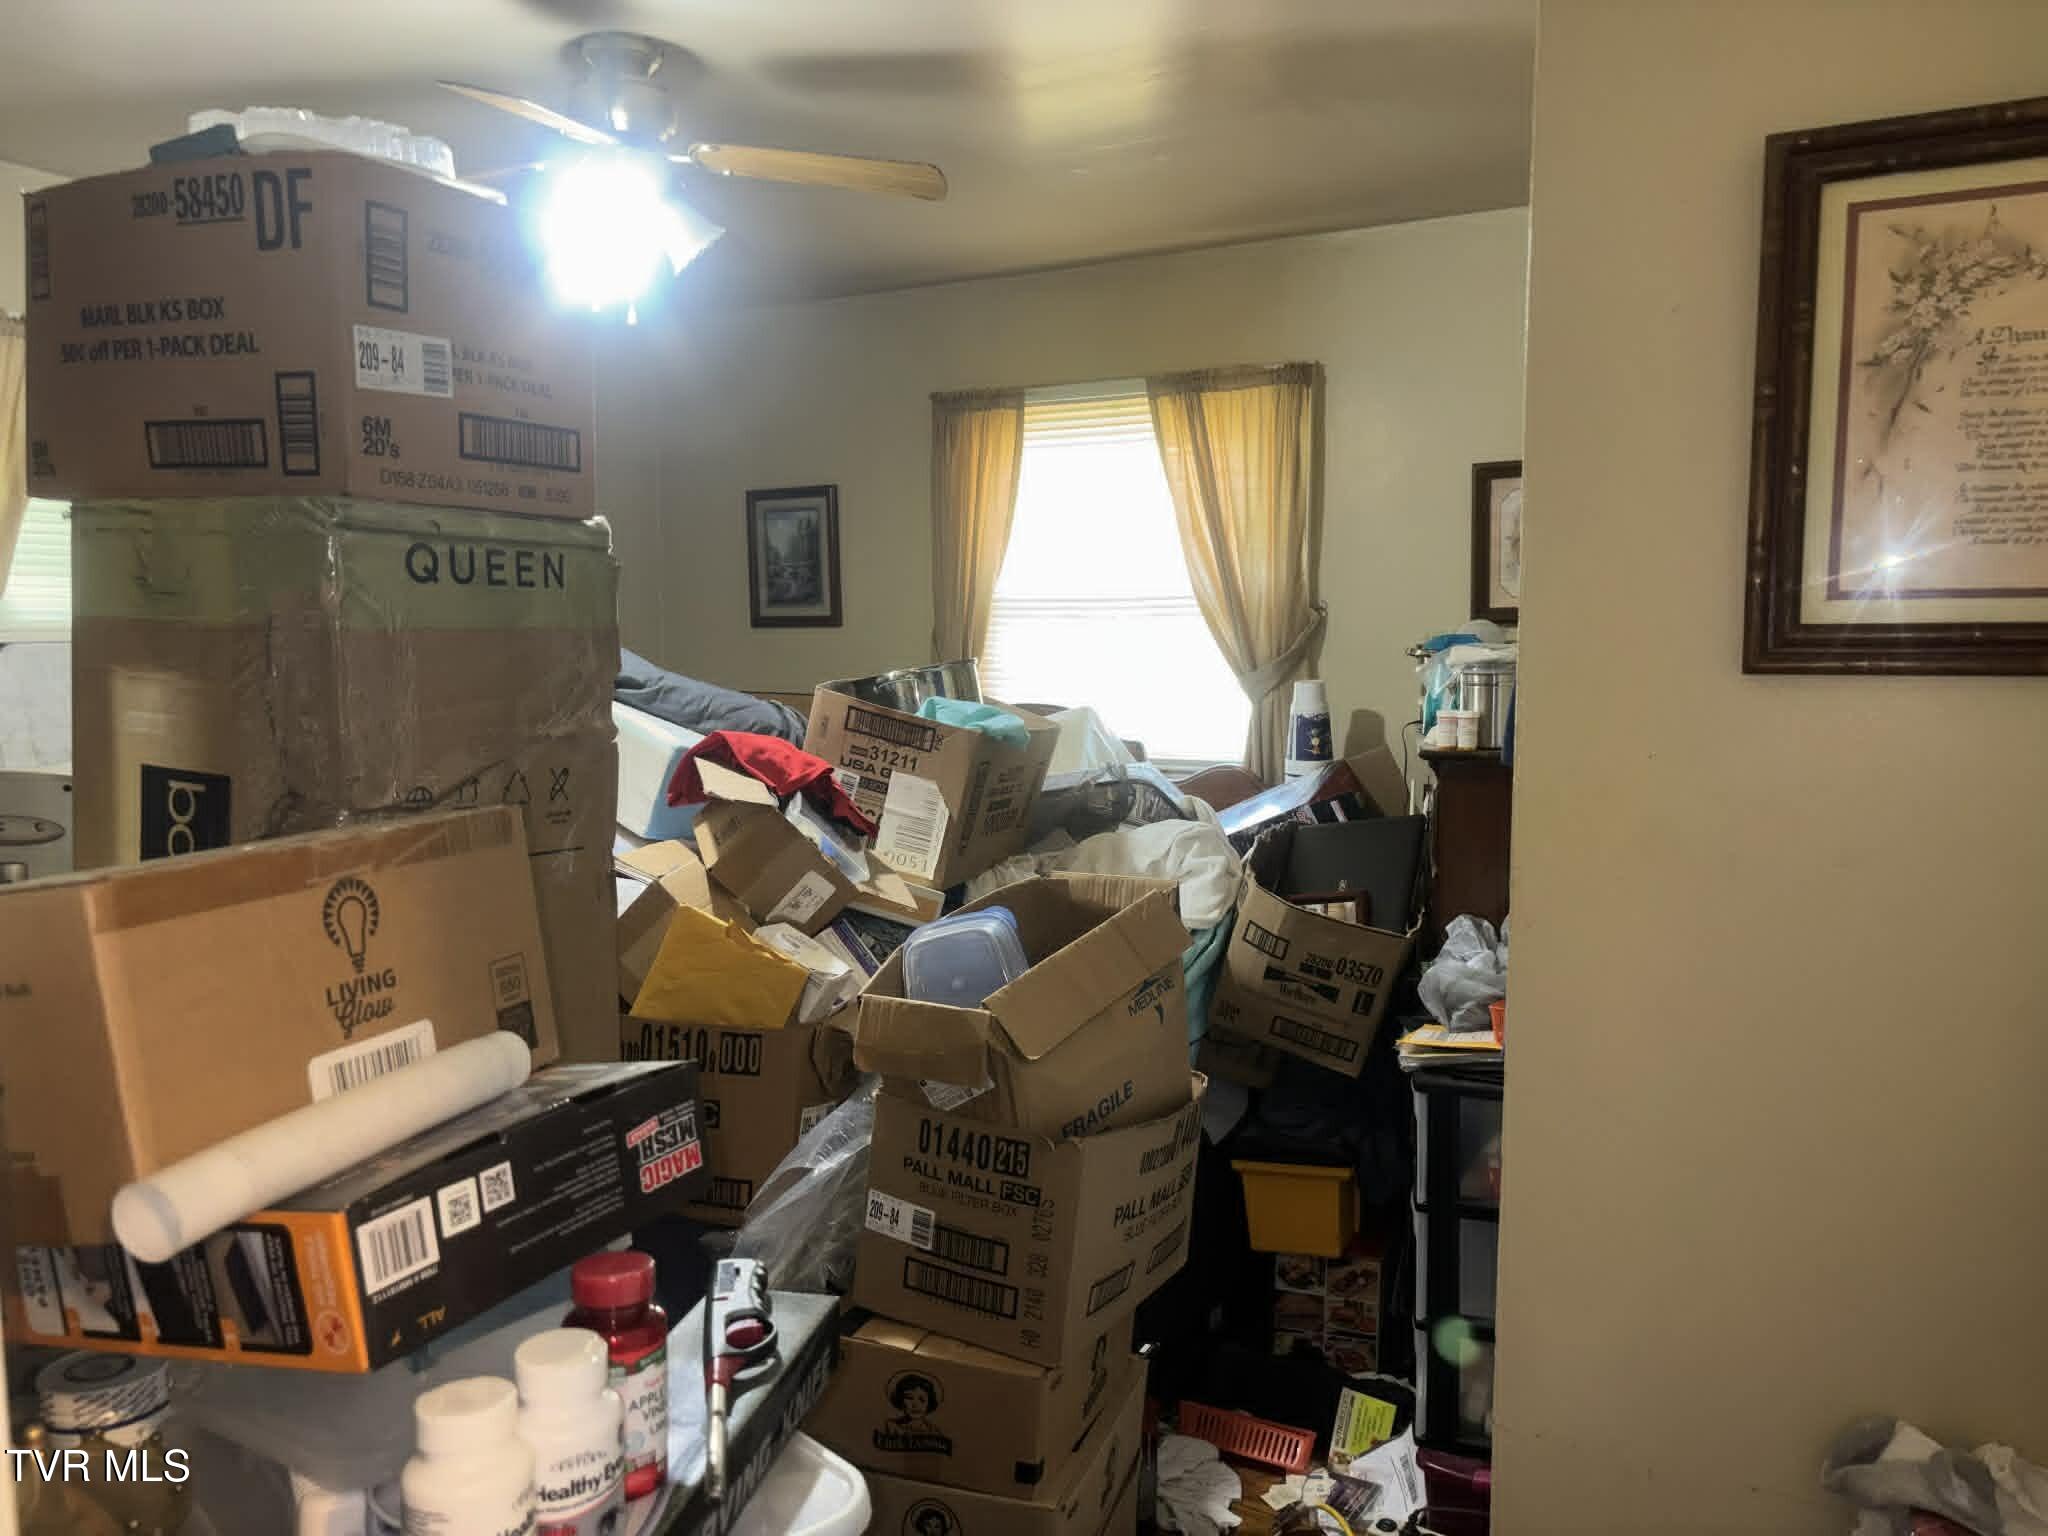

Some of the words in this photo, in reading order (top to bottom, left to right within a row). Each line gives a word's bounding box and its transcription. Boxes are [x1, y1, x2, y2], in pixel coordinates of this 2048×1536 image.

[174, 173, 245, 221] 58450
[253, 167, 313, 251] DF
[160, 299, 183, 320] KS
[187, 296, 225, 320] BOX
[112, 337, 143, 360] PER
[208, 330, 260, 356] DEAL
[361, 415, 391, 438] 6M
[405, 542, 566, 589] QUEEN
[840, 757, 877, 777] USA
[869, 744, 919, 772] 31211
[326, 968, 397, 1008] LIVING
[1335, 957, 1384, 986] 03570
[334, 996, 397, 1039] Glow
[1127, 974, 1177, 1018] MEDLINE
[720, 1035, 762, 1073] 000
[1061, 1080, 1135, 1140] FRAGILE
[639, 1114, 696, 1163] MESH
[919, 1118, 991, 1170] 01440
[996, 1140, 1028, 1175] 215
[640, 1141, 703, 1192] MAGIC
[903, 1156, 943, 1182] PALL
[947, 1169, 997, 1195] MALL
[1001, 1182, 1039, 1206] FSC
[1113, 1196, 1146, 1229] PALL
[1151, 1181, 1185, 1210] MALL
[536, 1472, 603, 1502] Healthy
